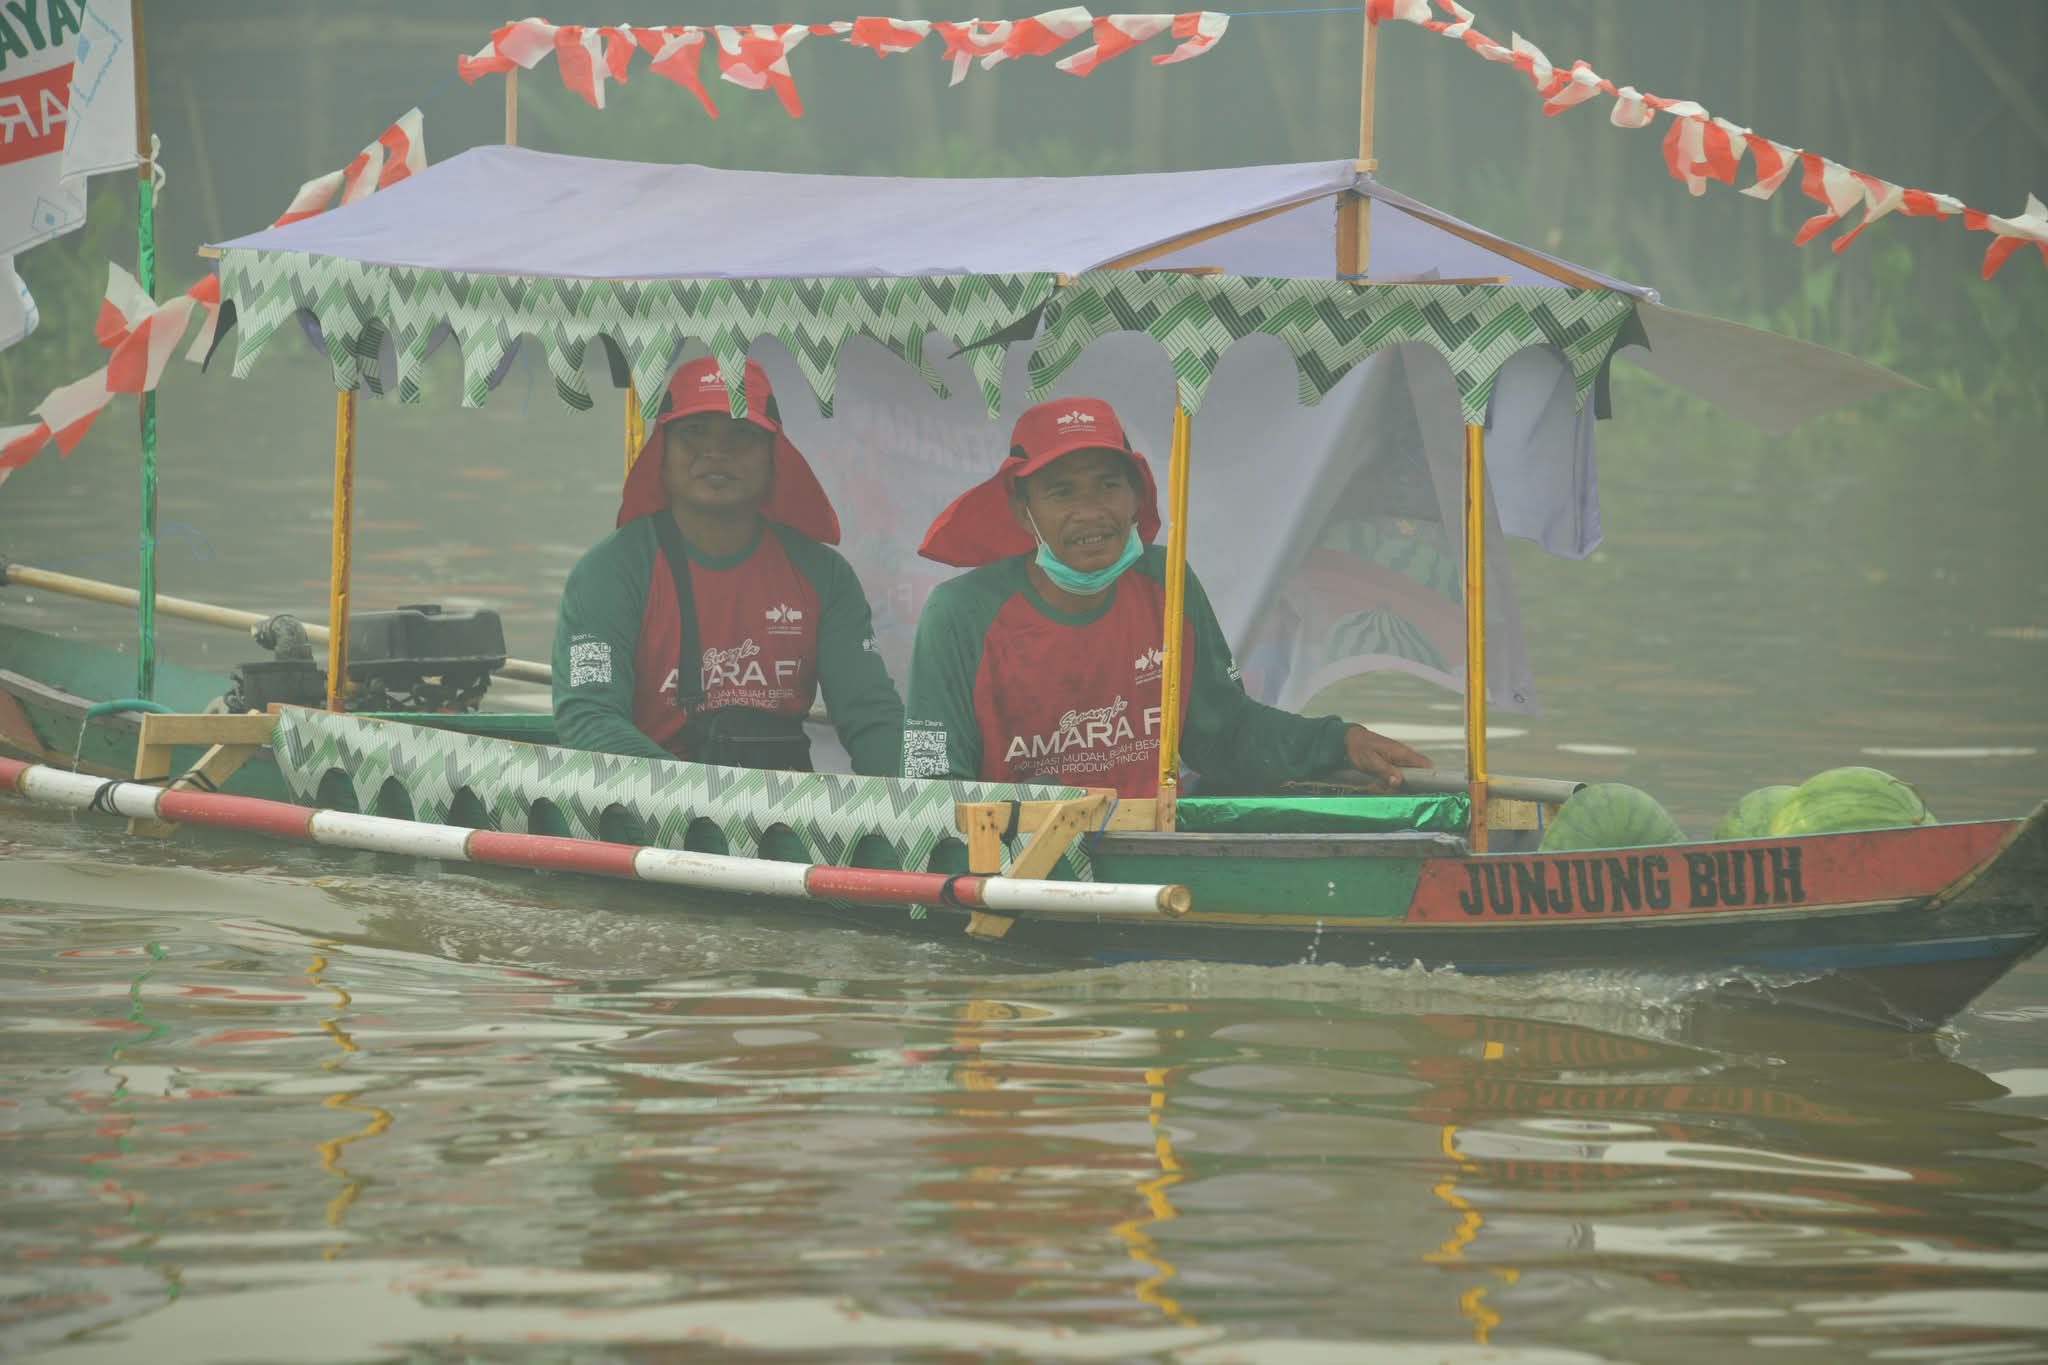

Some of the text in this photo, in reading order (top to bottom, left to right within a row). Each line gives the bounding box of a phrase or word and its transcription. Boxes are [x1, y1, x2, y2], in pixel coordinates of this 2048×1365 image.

[659, 660, 769, 693] AARA
[1004, 715, 1136, 763] AMARA
[1034, 766, 1060, 776] DAN
[1116, 750, 1150, 767] TINGGI
[1459, 846, 1806, 916] JUNJUNG BUIH
